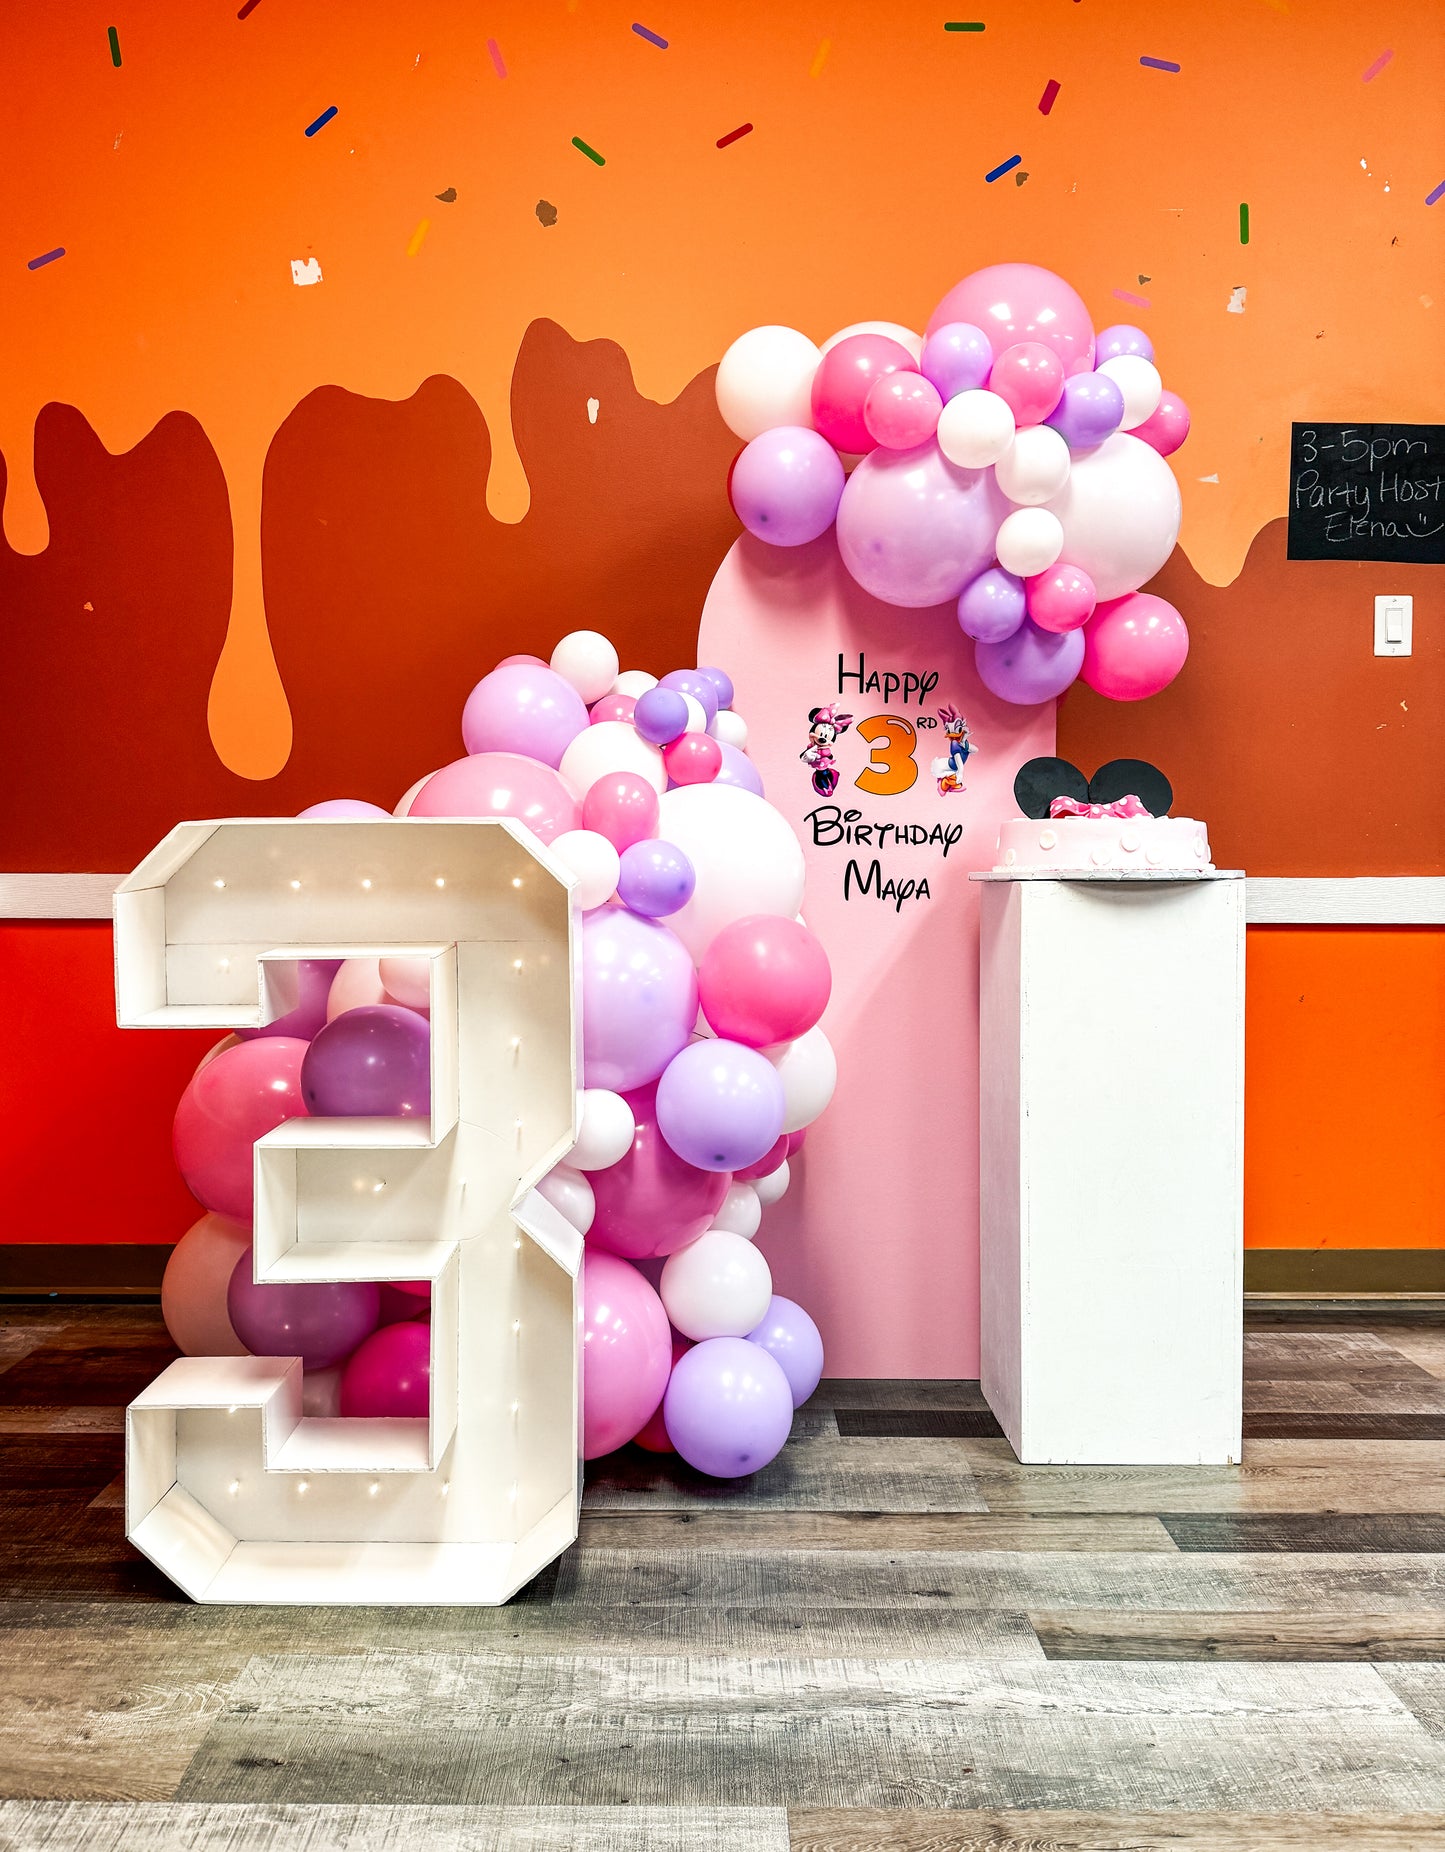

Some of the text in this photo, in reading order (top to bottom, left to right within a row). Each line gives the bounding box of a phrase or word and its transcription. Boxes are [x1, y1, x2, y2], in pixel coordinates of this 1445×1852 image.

[1295, 469, 1445, 523] Party Host
[113, 817, 584, 1606] 3
